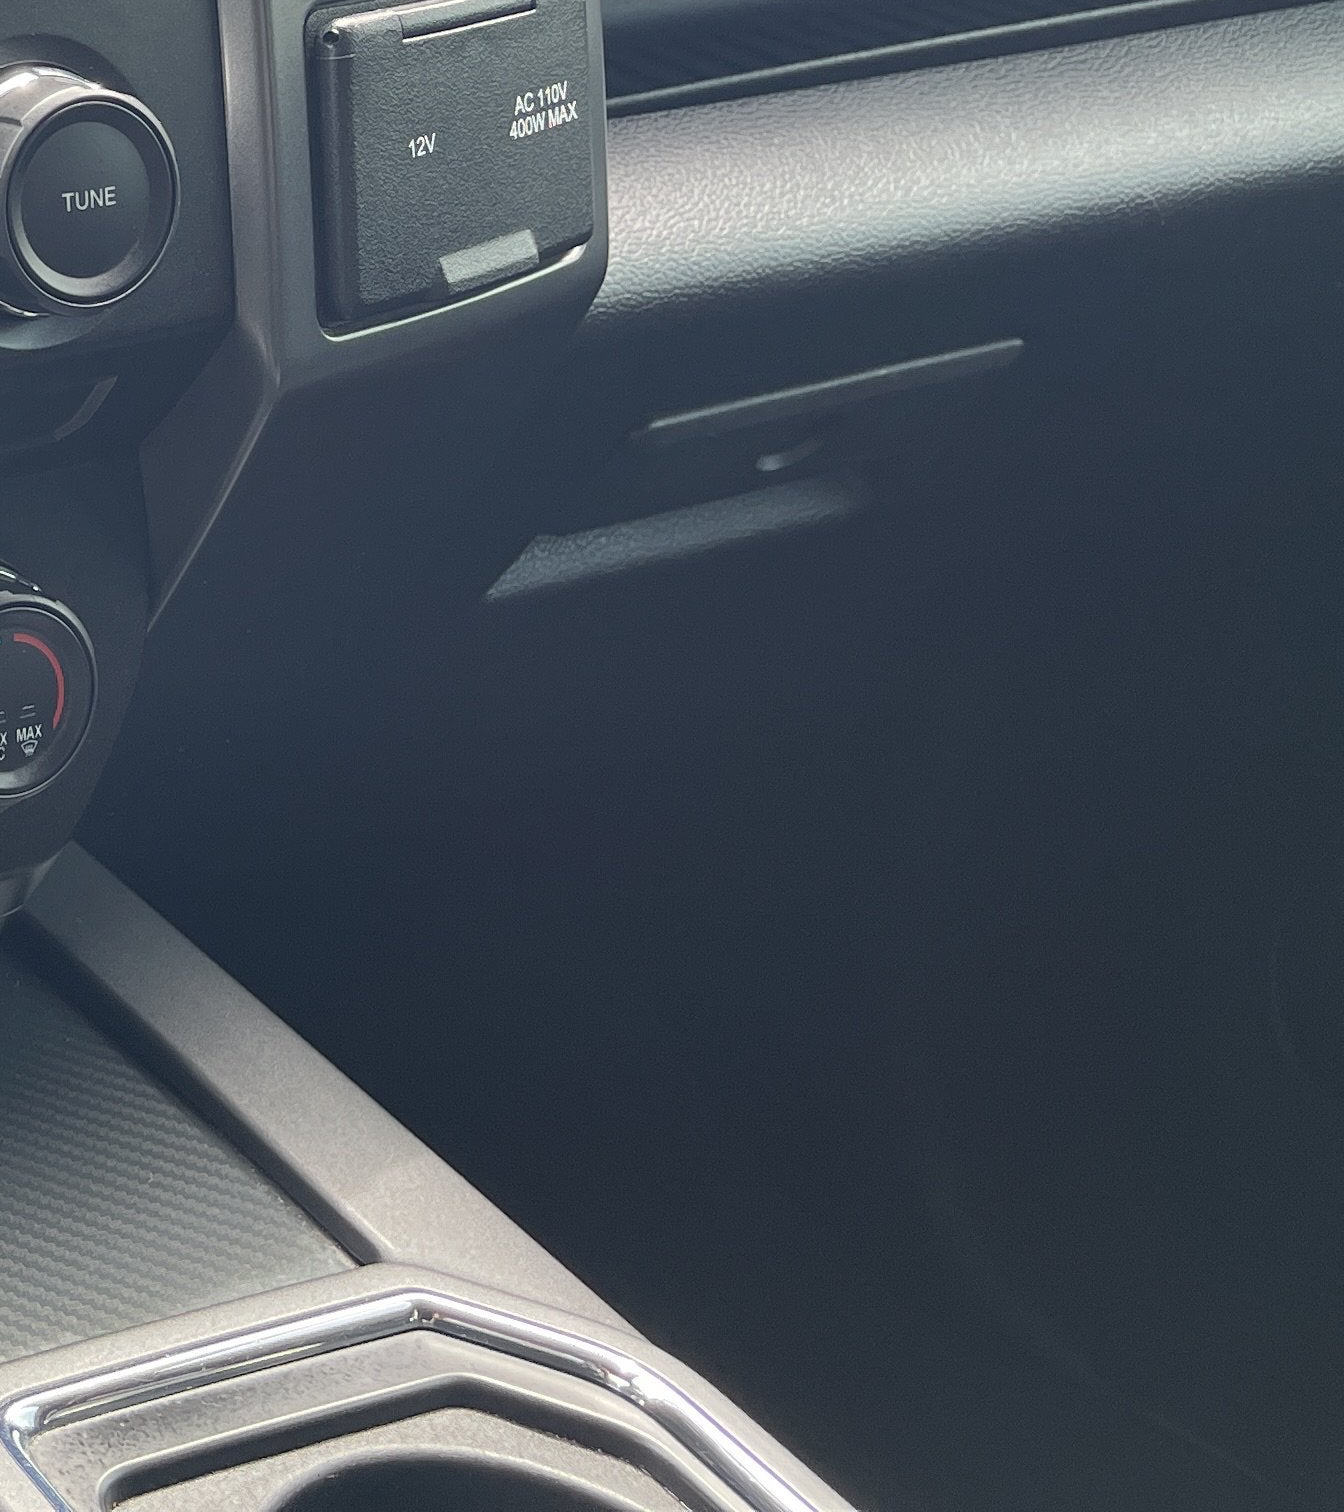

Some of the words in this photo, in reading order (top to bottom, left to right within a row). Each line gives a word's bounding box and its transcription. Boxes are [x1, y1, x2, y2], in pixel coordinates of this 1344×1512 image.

[514, 91, 535, 117] AC
[537, 79, 568, 108] 110V
[509, 110, 546, 140] 400W
[547, 100, 579, 129] MAX
[408, 132, 437, 159] 12V
[61, 185, 118, 213] TUNE
[15, 723, 43, 743] MAX
